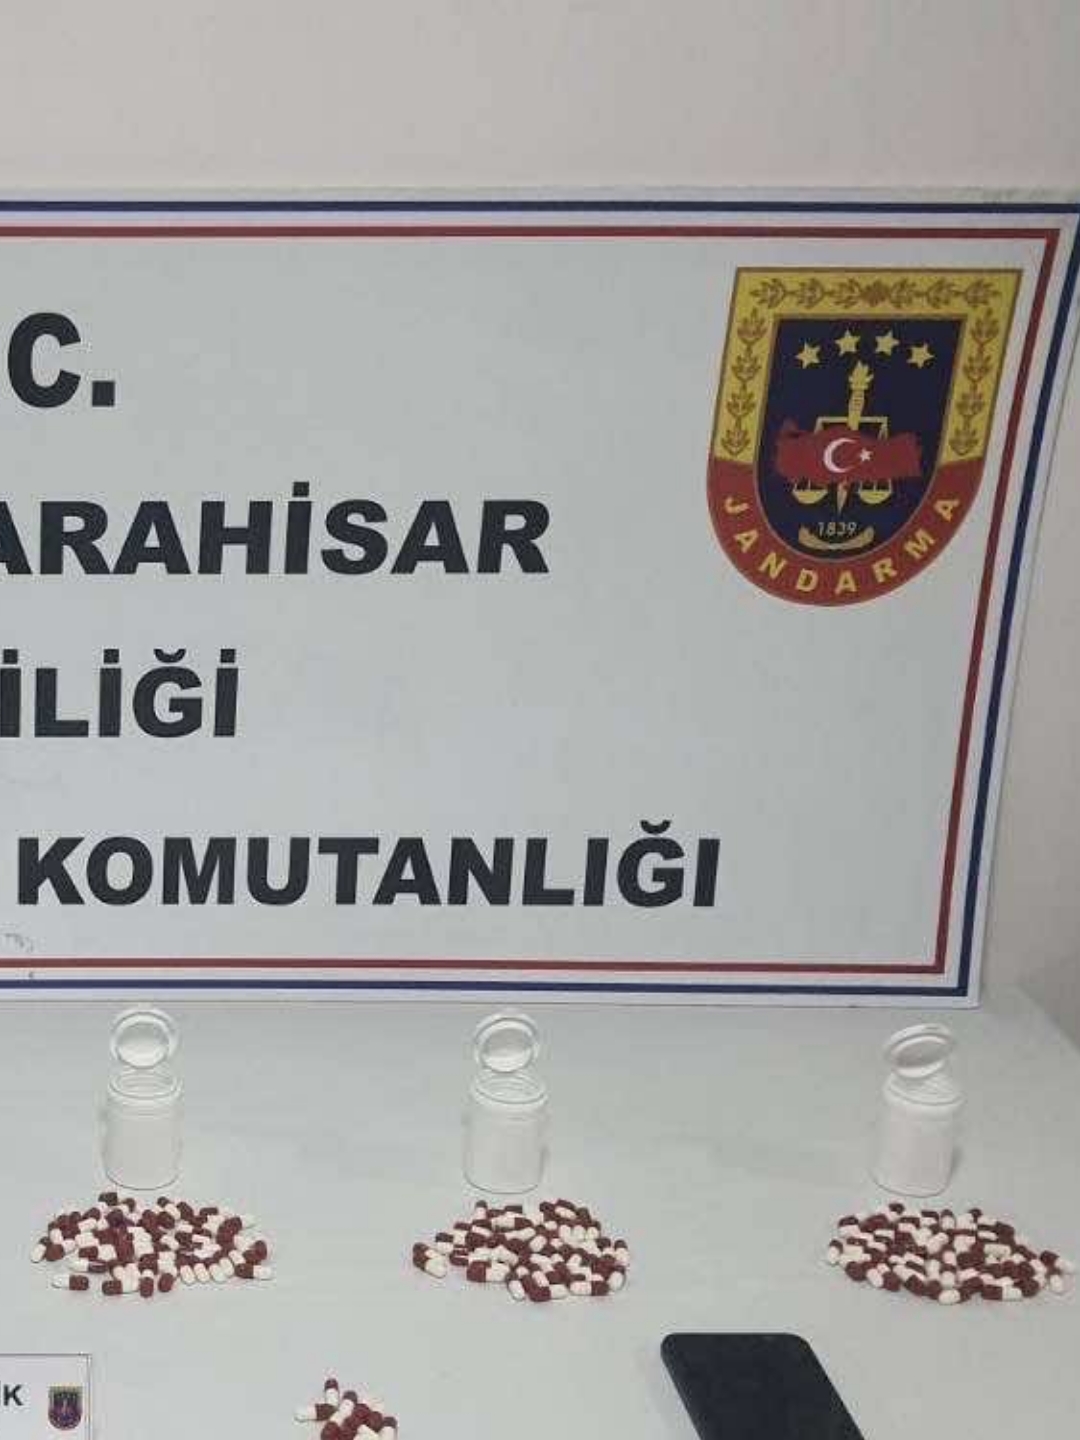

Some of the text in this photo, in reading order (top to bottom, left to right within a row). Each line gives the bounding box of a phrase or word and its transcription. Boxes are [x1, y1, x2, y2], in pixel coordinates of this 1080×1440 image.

[724, 496, 960, 595] JANDARMA
[817, 521, 858, 536] 1839
[18, 819, 721, 908] KOMUTANLIĞI
